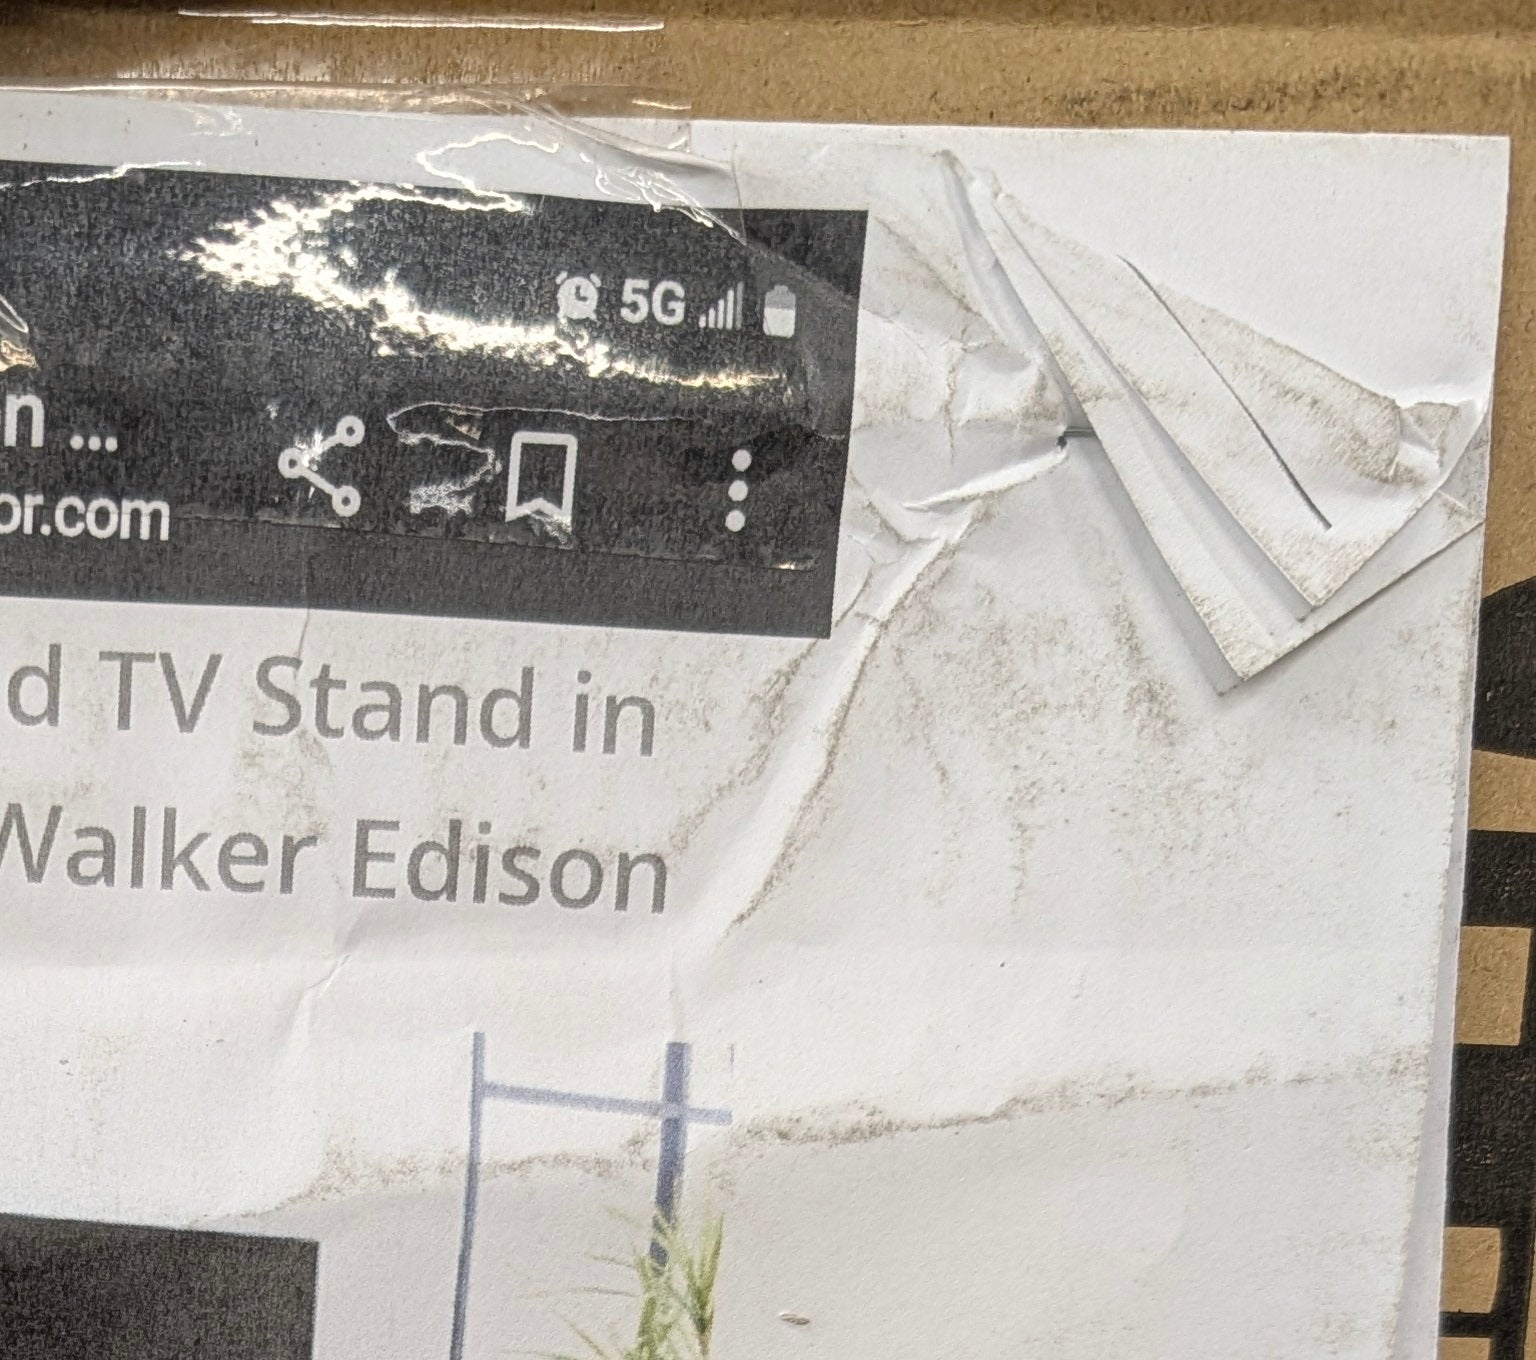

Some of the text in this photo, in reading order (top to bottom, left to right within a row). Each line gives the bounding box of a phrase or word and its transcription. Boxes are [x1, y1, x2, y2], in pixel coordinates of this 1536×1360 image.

[621, 279, 685, 325] 5G
[99, 651, 222, 733] TV
[252, 651, 534, 749] Stand
[573, 669, 656, 757] in
[352, 818, 668, 914] Edison
